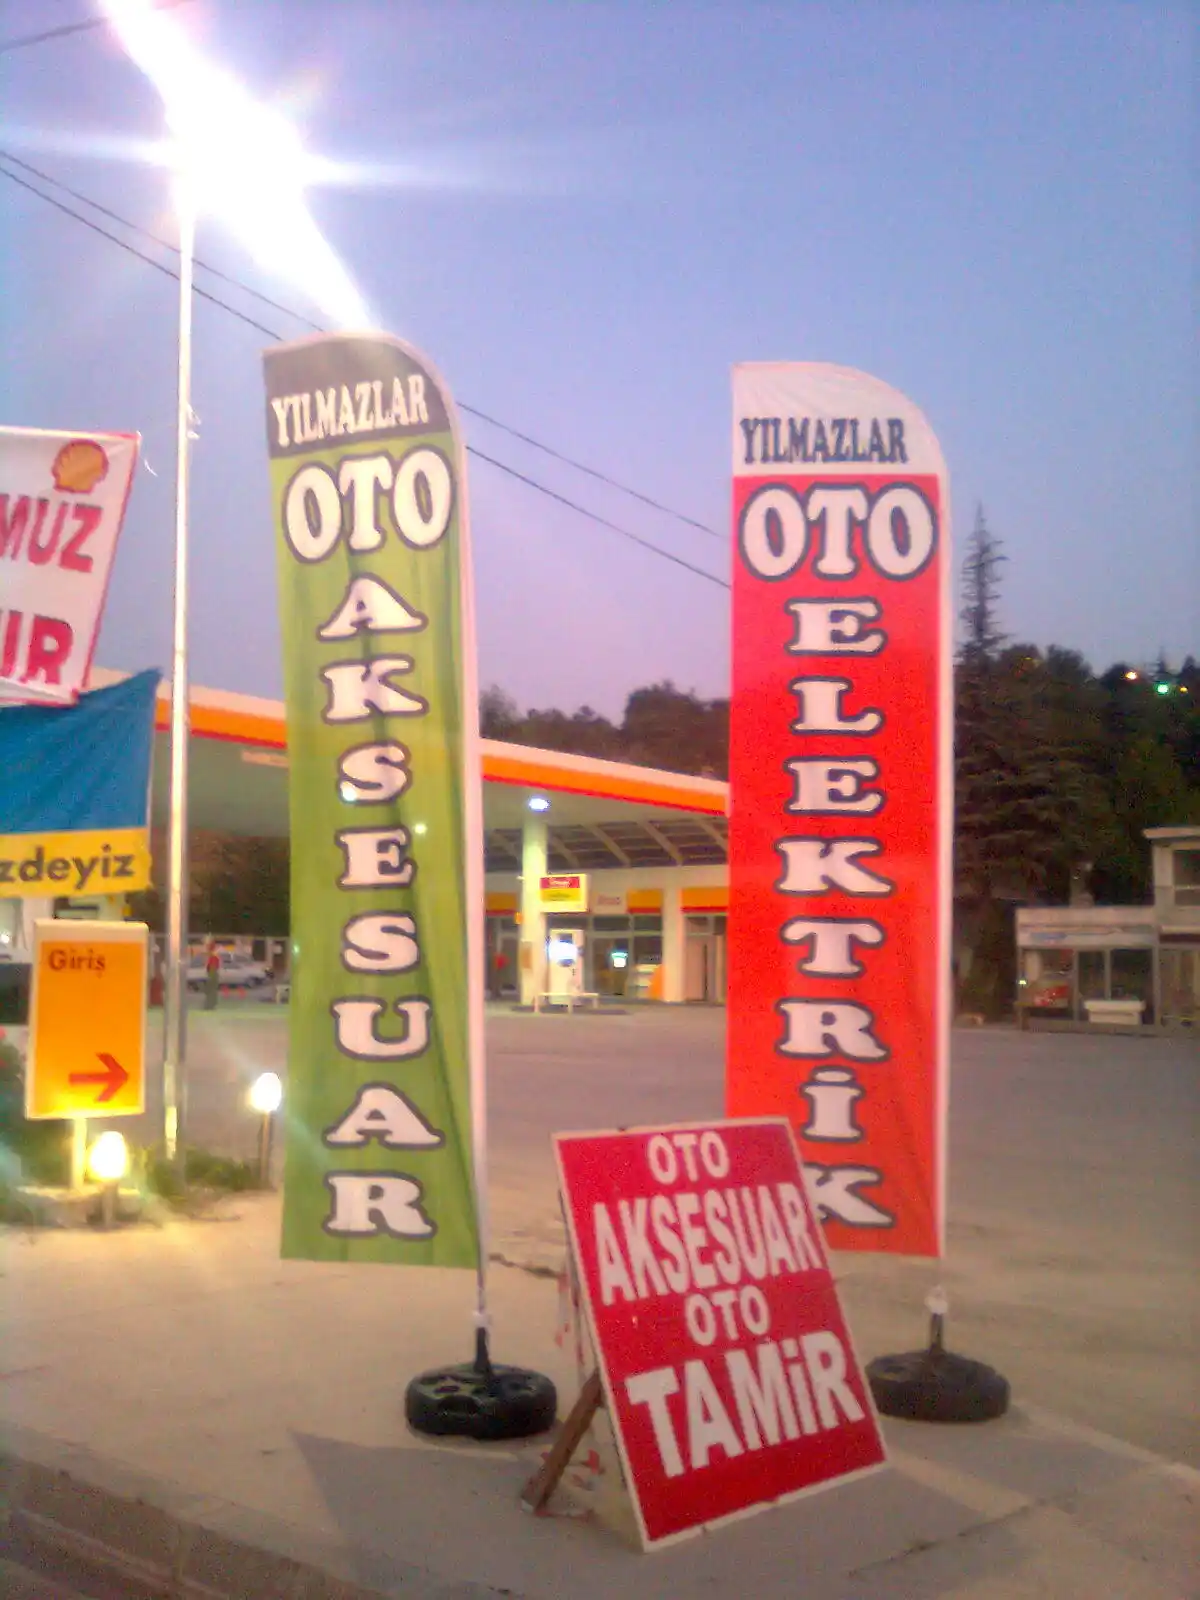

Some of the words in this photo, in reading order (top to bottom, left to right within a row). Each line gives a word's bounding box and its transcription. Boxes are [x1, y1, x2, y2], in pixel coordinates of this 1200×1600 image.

[271, 375, 430, 447] YILMAZLAR
[739, 417, 909, 464] YILMAZLAR
[284, 446, 453, 562] OTO
[740, 483, 936, 581] OTO
[319, 573, 443, 1238] AKSESUAR
[48, 946, 106, 979] Giriş
[647, 1131, 730, 1185] OTO
[592, 1182, 821, 1306] AKSESUAR
[685, 1285, 769, 1346] OTO
